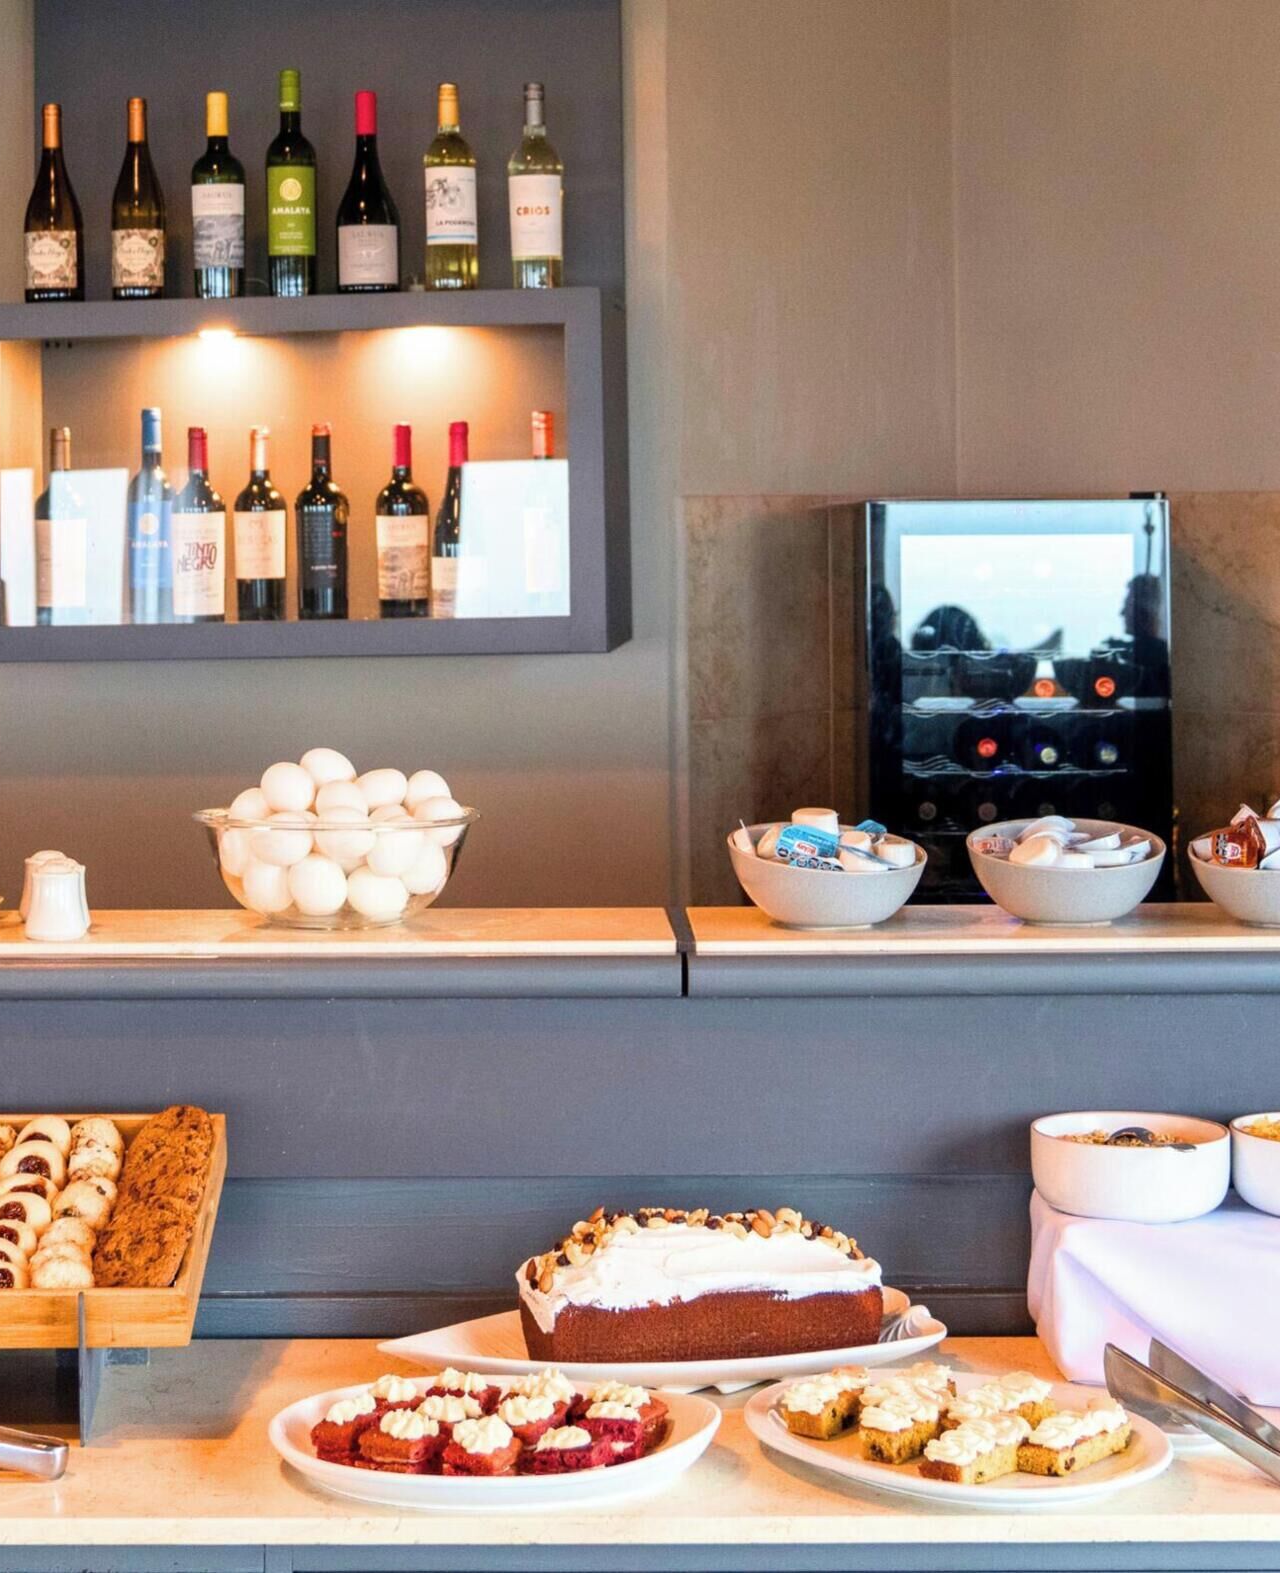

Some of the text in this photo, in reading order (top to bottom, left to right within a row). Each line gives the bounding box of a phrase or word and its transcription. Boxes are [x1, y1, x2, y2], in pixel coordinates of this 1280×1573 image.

[272, 207, 311, 215] AMALAYA
[516, 206, 550, 215] CRIOS
[184, 542, 218, 566] TINTO
[177, 555, 215, 574] NEGRO
